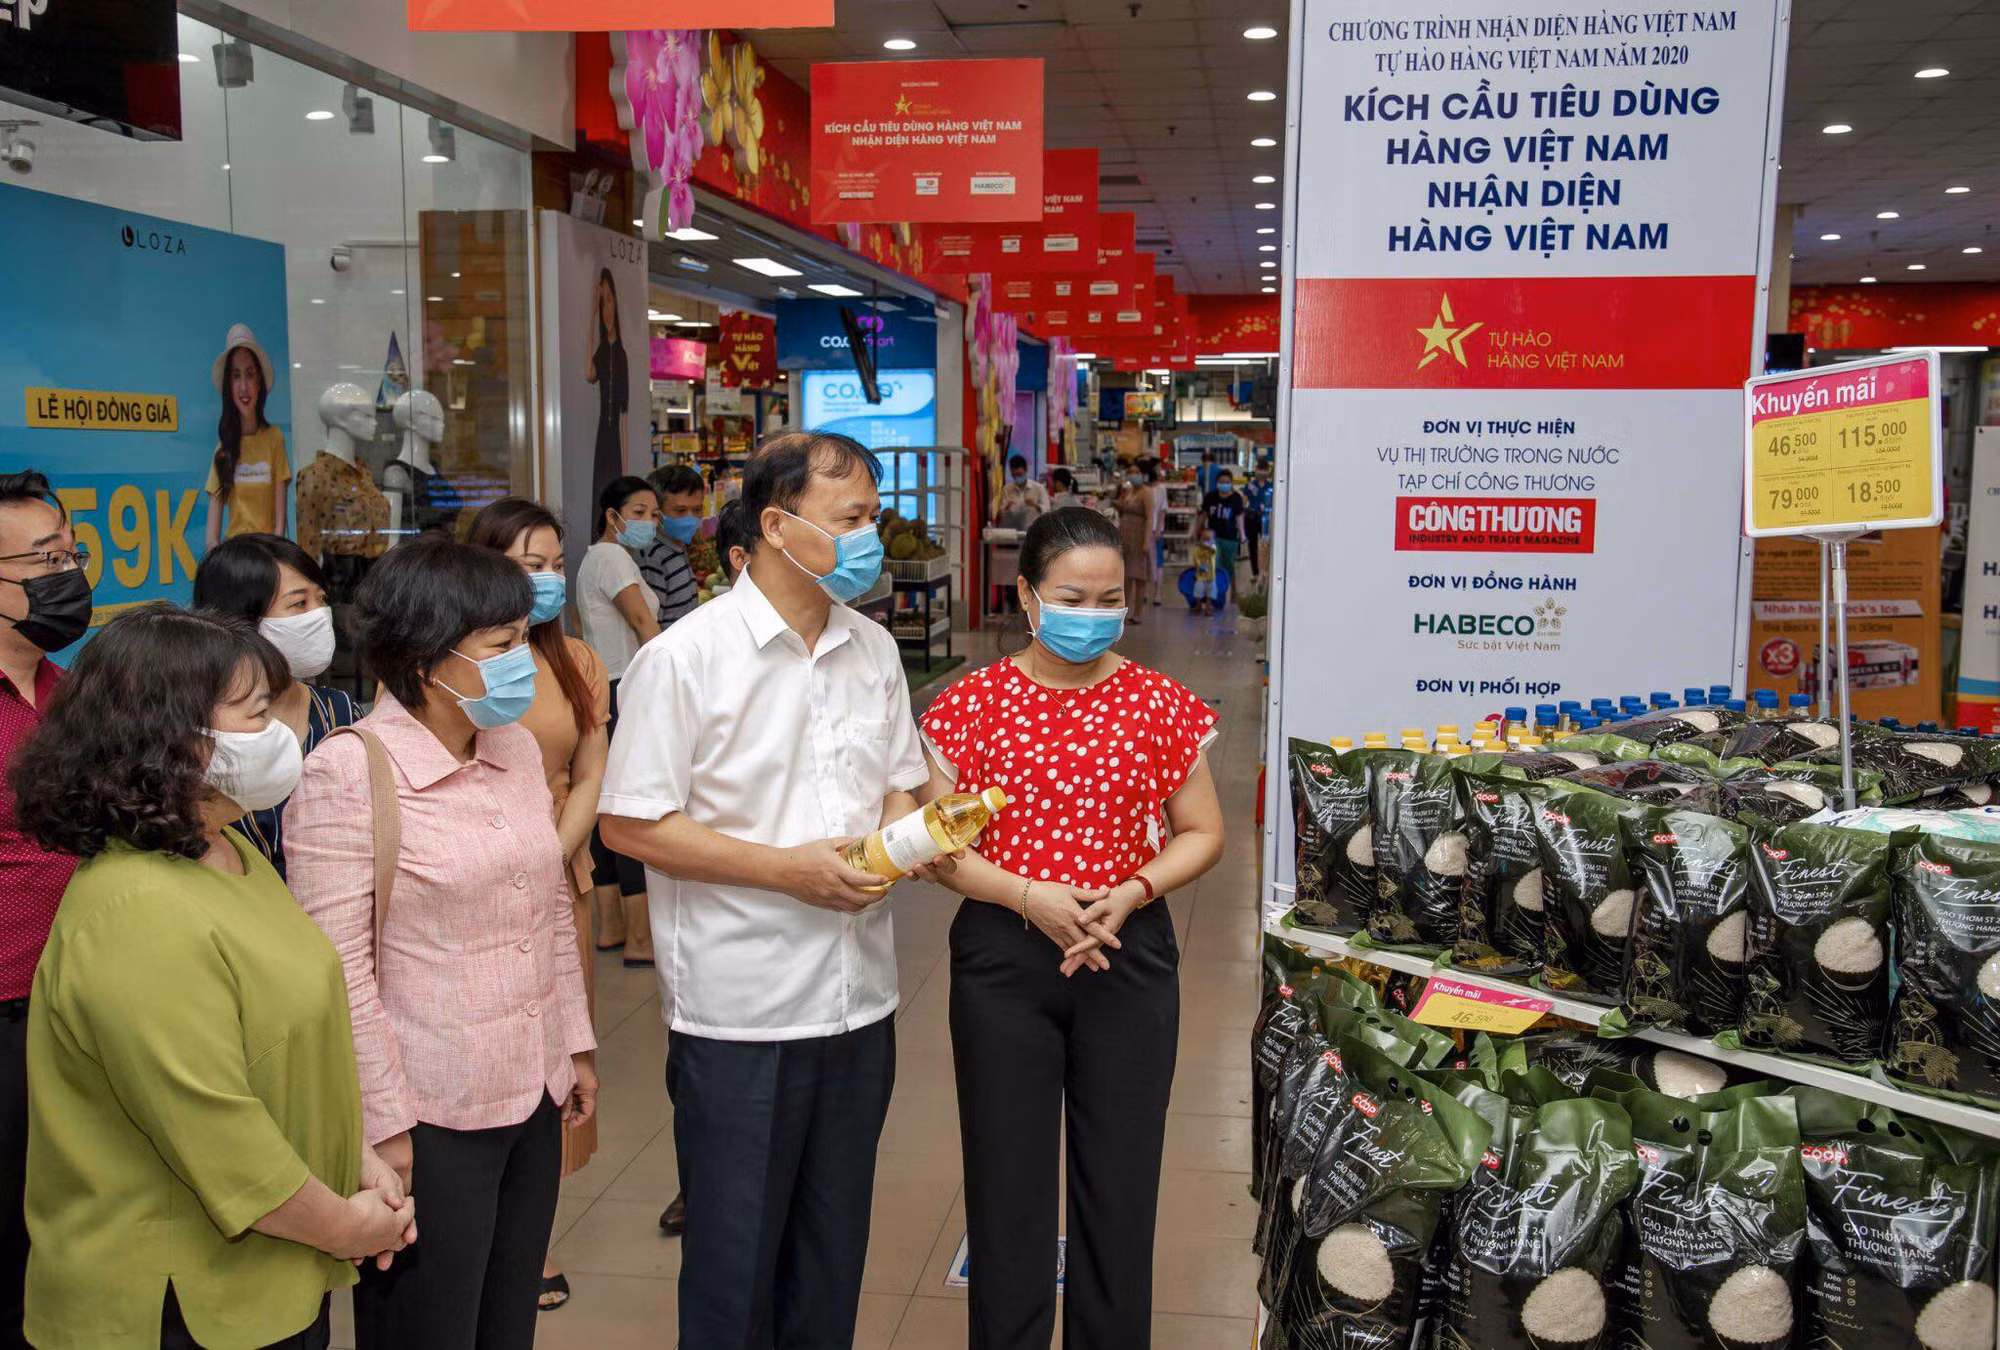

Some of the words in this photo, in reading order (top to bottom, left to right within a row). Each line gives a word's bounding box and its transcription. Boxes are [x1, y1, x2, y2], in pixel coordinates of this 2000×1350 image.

[1329, 20, 1408, 42] CHƯƠNG
[1414, 15, 1470, 40] TRÌNH
[1475, 16, 1528, 40] NHẬN
[1533, 15, 1579, 40] DIỆN
[1583, 12, 1637, 37] HÀNG
[1642, 12, 1689, 38] VIỆT
[1692, 10, 1737, 31] NAM
[1375, 50, 1400, 75] TỰ
[1405, 45, 1444, 72] HÀO
[1449, 44, 1503, 71] HÀNG
[1508, 44, 1551, 74] VIỆT
[1555, 47, 1599, 70] NAM
[1603, 42, 1647, 69] NĂM
[1652, 45, 1689, 66] 2020
[1344, 86, 1429, 121] KÍCH
[1442, 78, 1519, 120] CẦU
[1530, 83, 1600, 118] TIÊU
[1612, 81, 1721, 117] DÙNG
[825, 122, 851, 134] KÍCH
[853, 118, 878, 133] CẦU
[879, 120, 900, 132] TIÊU
[903, 121, 934, 132] DÙNG
[937, 119, 969, 131] HÀNG
[971, 119, 993, 132] VIỆT
[996, 120, 1022, 130] NAM
[852, 134, 883, 149] NHẬN
[885, 134, 910, 149] DIỆN
[912, 132, 944, 145] HÀNG
[946, 132, 969, 147] VIỆT
[971, 133, 996, 144] NAM
[1387, 130, 1491, 165] HÀNG
[1503, 128, 1575, 170] VIỆT
[1585, 133, 1669, 162] NAM
[1427, 173, 1529, 216] NHẬN
[1541, 172, 1621, 215] DIỆN
[137, 228, 187, 256] LOZA
[1389, 218, 1492, 252] HÀNG
[1504, 217, 1575, 258] VIỆT
[1585, 223, 1669, 250] NAM
[1488, 329, 1509, 349] TỰ
[1512, 327, 1552, 346] HÀO
[1488, 348, 1540, 370] HÀNG
[1544, 350, 1579, 372] VIỆT
[1583, 353, 1624, 369] NAM
[1752, 380, 1829, 417] Khuyến
[1836, 376, 1877, 404] mãi
[63, 396, 93, 426] HỘI
[146, 399, 172, 424] GIÁ
[1423, 419, 1461, 435] ĐƠN
[1466, 421, 1483, 439] VỊ
[1487, 419, 1533, 439] THỰC
[1537, 417, 1576, 439] HIỆN
[1377, 445, 1401, 466] VỤ
[1403, 447, 1427, 467] THỊ
[1430, 443, 1500, 464] TRƯỜNG
[1504, 447, 1563, 465] TRONG
[1567, 443, 1620, 465] NƯỚC
[1398, 473, 1428, 493] TẠP
[1432, 471, 1461, 491] CHÍ
[1465, 469, 1520, 492] CÔNG
[1524, 473, 1596, 492] THƯƠNG
[1409, 534, 1459, 544] INDUSTRY
[1462, 534, 1485, 544] AND
[1489, 535, 1521, 544] TRADE
[1523, 535, 1581, 545] MAGAZINE
[1408, 573, 1445, 589] ĐƠN
[1451, 576, 1467, 592] VỊ
[1472, 571, 1524, 591] ĐỒNG
[1528, 574, 1577, 591] HÀNH
[1413, 613, 1535, 636] HABECO
[1457, 639, 1479, 650] Sức
[1505, 640, 1529, 653] Việt
[1533, 642, 1561, 651] Nam
[1416, 678, 1453, 693] ĐƠN
[1459, 680, 1475, 697] VỊ
[1480, 676, 1520, 695] PHỐI
[1525, 681, 1561, 699] HỢP
[1773, 858, 1848, 880] Finest
[1433, 981, 1464, 996] Khuyến
[1831, 1167, 1953, 1217] Finest
[1846, 1237, 1896, 1259] THƯỢNG
[1908, 1234, 1921, 1243] ST
[1853, 1253, 1862, 1261] 24
[1924, 1264, 1940, 1273] Rice
